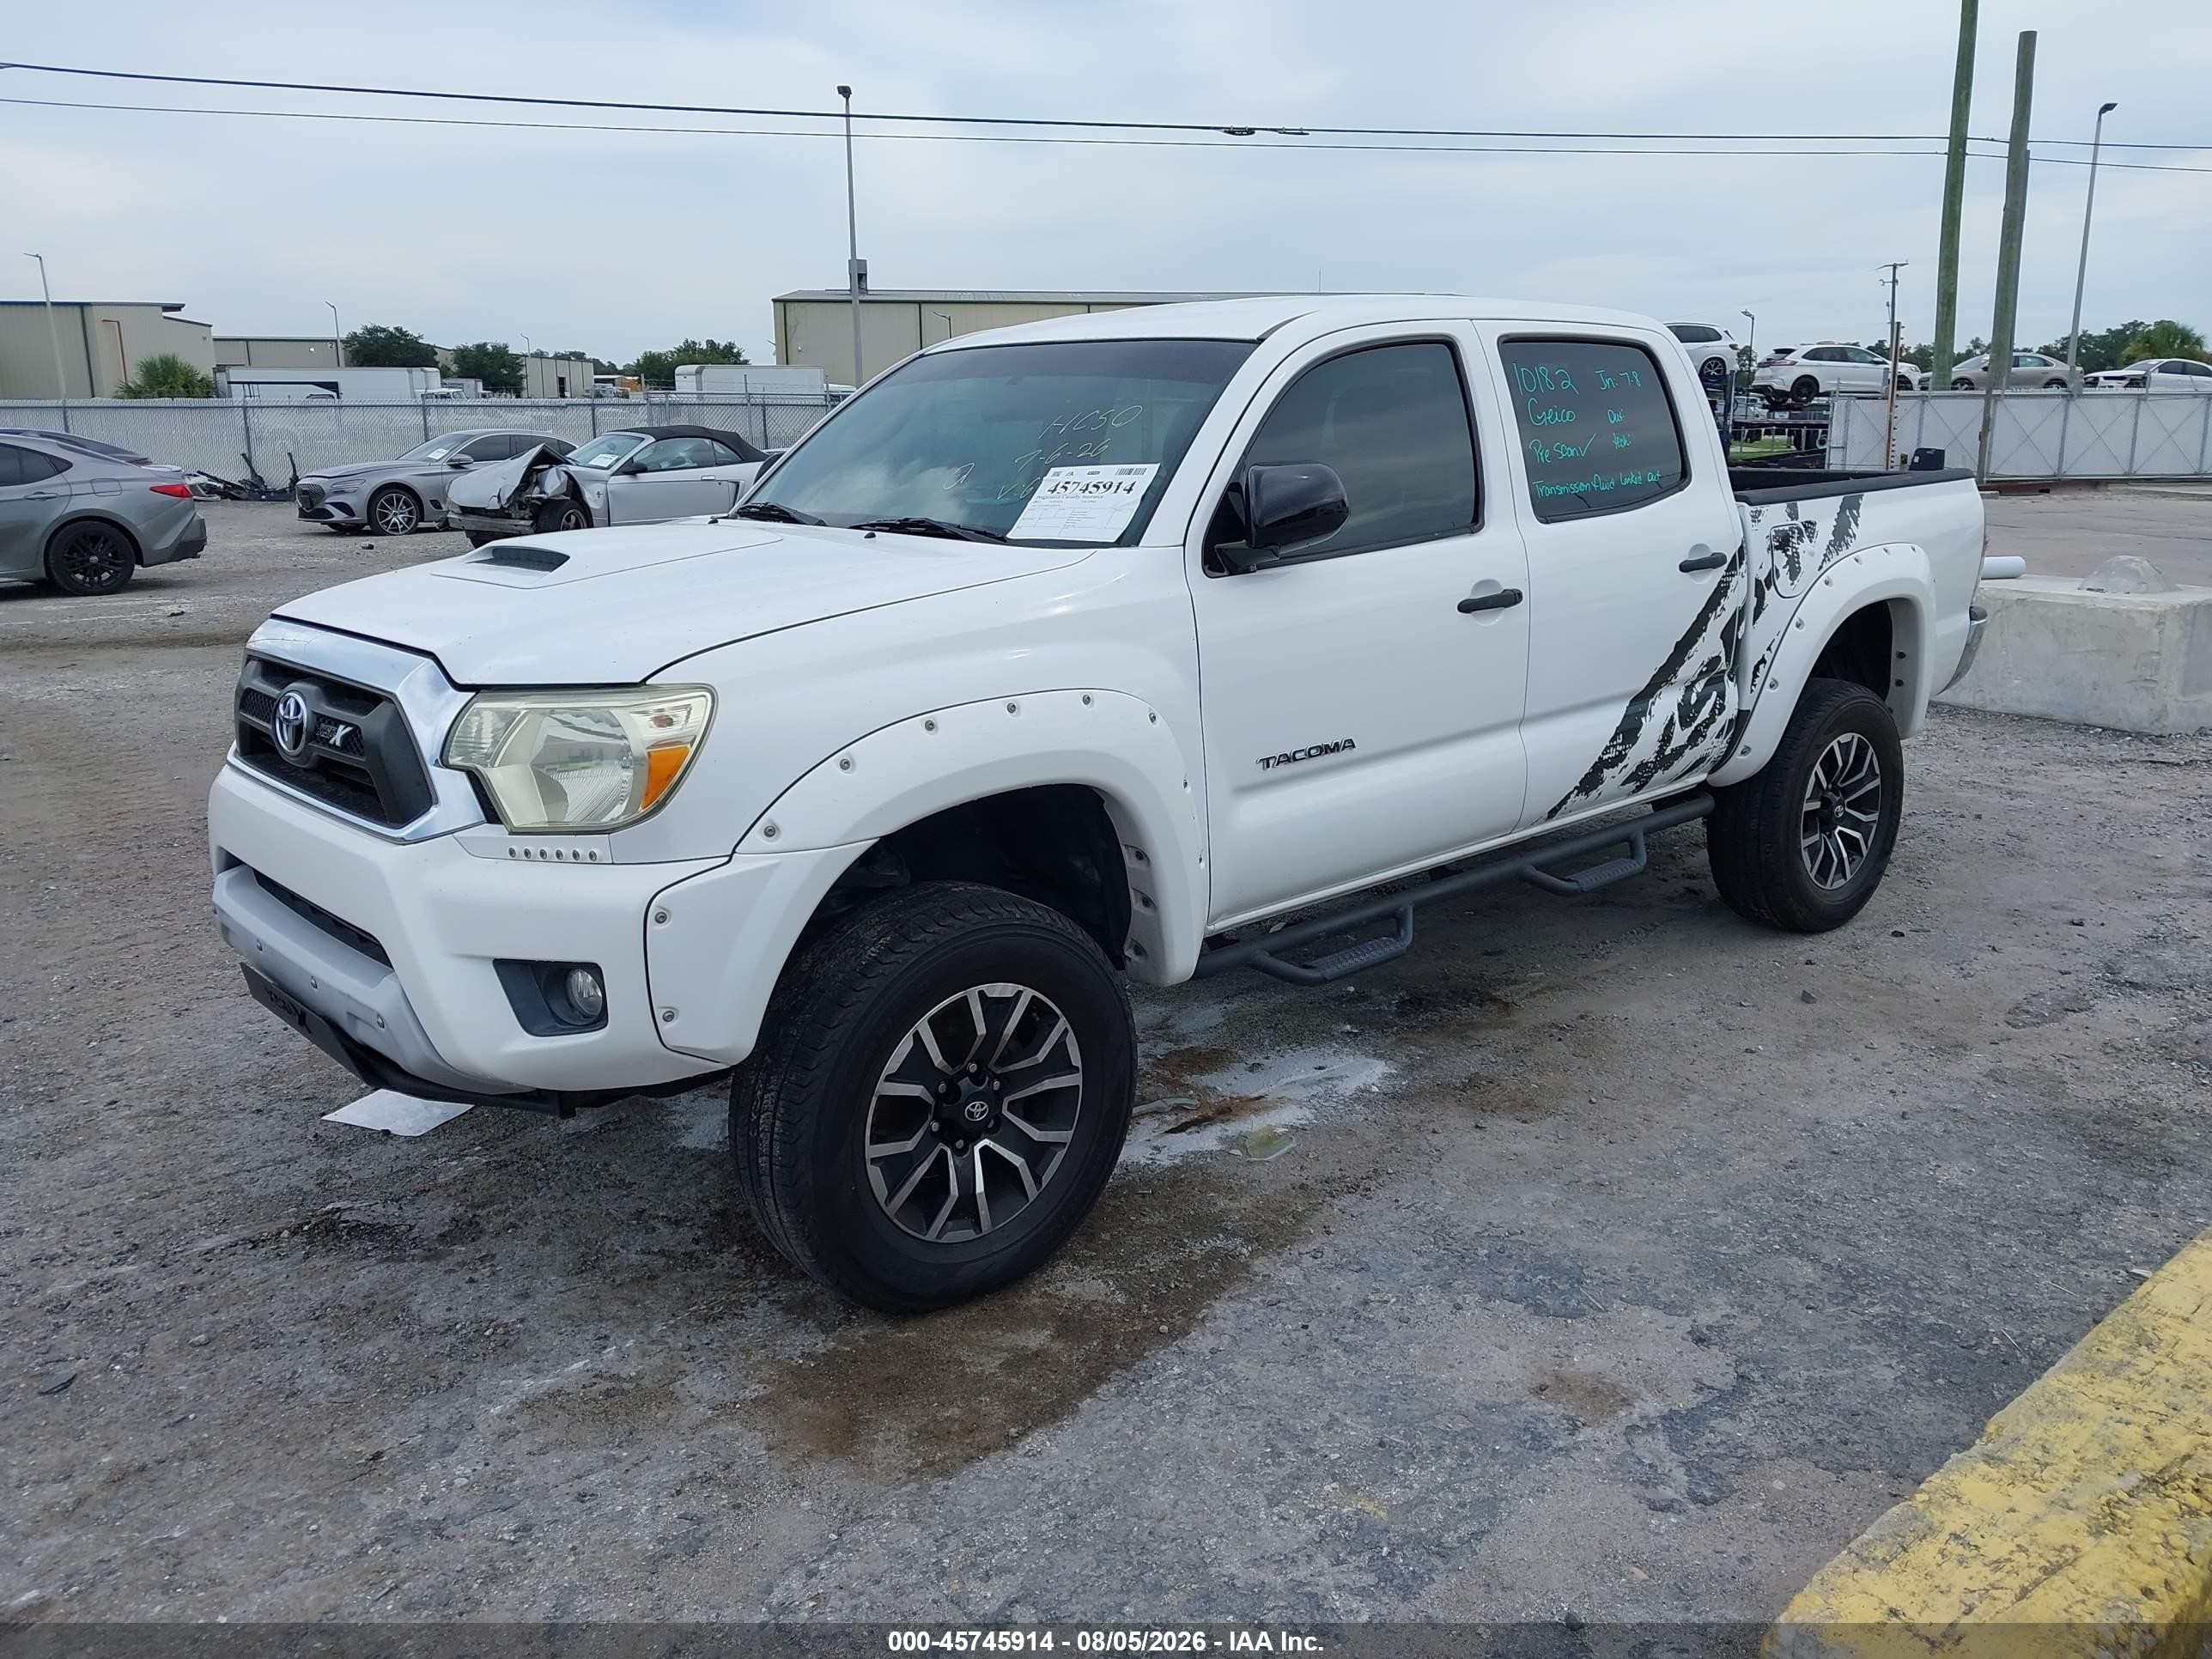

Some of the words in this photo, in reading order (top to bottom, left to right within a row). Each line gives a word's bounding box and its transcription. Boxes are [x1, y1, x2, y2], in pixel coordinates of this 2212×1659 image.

[1512, 362, 1579, 395] 10182
[1528, 398, 1576, 425] Geico
[1048, 480, 1137, 495] 45745914
[1256, 738, 1357, 770] TACOMA
